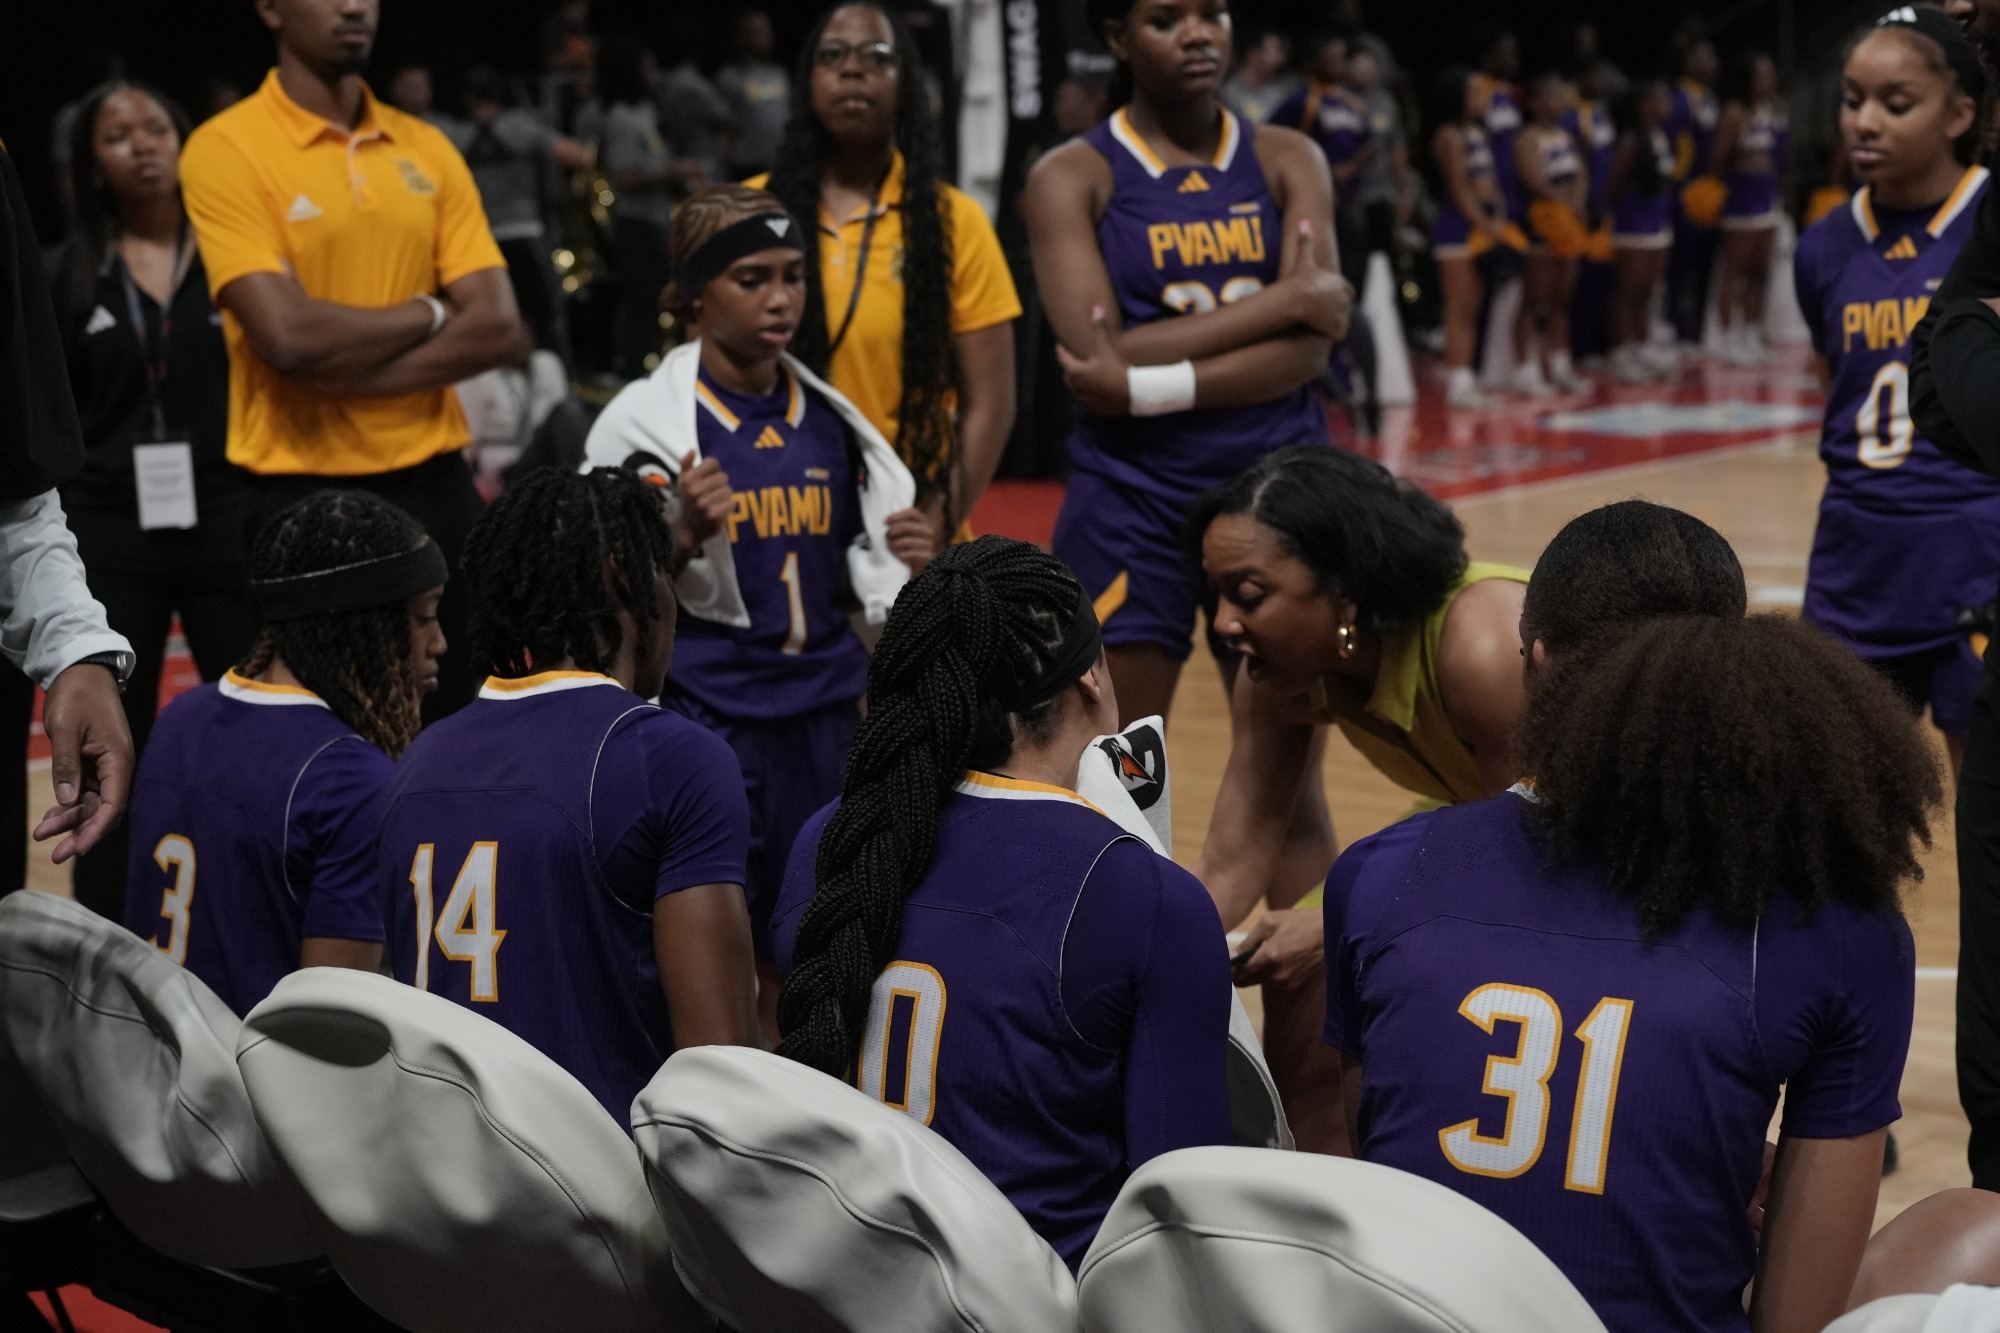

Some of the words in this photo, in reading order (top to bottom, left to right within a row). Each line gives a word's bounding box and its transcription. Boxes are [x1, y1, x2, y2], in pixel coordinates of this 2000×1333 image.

[1147, 216, 1266, 270] PVAMU
[1856, 360, 1915, 470] 0
[727, 484, 833, 544] PVAMU
[779, 551, 808, 656] 1
[147, 833, 197, 967] 3
[409, 841, 508, 1002] 14
[1438, 982, 1635, 1195] 31
